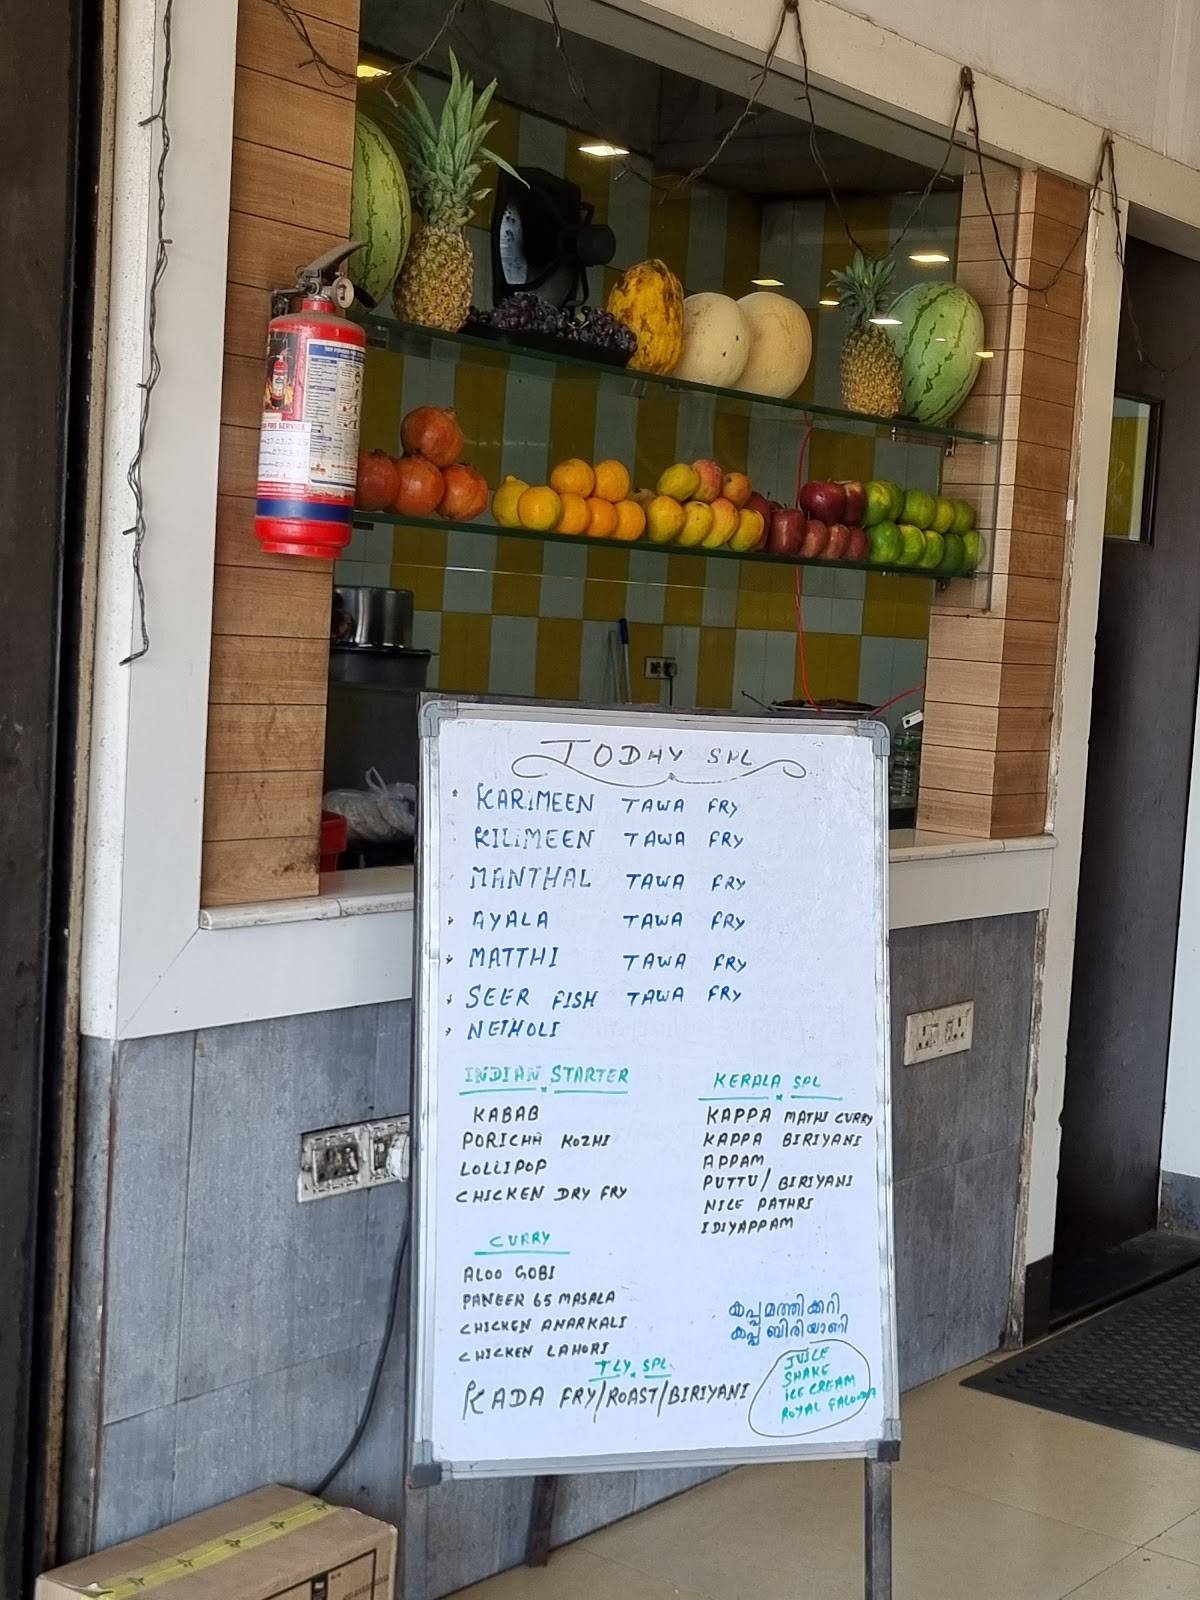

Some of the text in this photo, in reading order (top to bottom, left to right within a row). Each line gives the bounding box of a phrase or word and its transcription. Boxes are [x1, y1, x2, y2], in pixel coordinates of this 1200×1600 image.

[621, 797, 685, 814] TAWA
[707, 797, 739, 818] FRY
[624, 830, 686, 848] TAWA
[709, 830, 744, 849] FRY
[470, 866, 746, 892] MANTHAL TAWA FRY
[472, 910, 746, 931] AYALA TAWA FRY
[469, 947, 747, 973] MATTHI TAWA FRY
[465, 984, 742, 1010] SEER FISH TAWA FRY
[464, 1064, 630, 1084] INDIAN STARTER
[713, 1072, 822, 1089] KERALA SPL
[473, 1104, 540, 1124] KABAB
[706, 1105, 772, 1126] KAPPA
[834, 1112, 874, 1127] CURRY
[561, 1133, 612, 1150] KOZHI
[703, 1131, 864, 1148] KAPPA BIRIYANI
[702, 1153, 765, 1170] APPAM
[778, 1173, 854, 1191] BIRIYANI
[455, 1185, 628, 1204] CHICKEN DRY FRY
[700, 1216, 794, 1236] IDIYAPPAM
[488, 1230, 551, 1247] CURRY
[463, 1264, 557, 1283] ALOO GOBI
[462, 1290, 616, 1310] PANEER 65 MASALA
[459, 1315, 628, 1335] CHICKEN ANARKALI
[458, 1342, 611, 1363] CHICKEN LAHORI
[642, 1356, 668, 1373] SPL
[781, 1363, 831, 1388] SHAKE
[808, 1374, 856, 1396] CREAM
[462, 1379, 546, 1420] KADA
[780, 1401, 821, 1425] ROYAL
